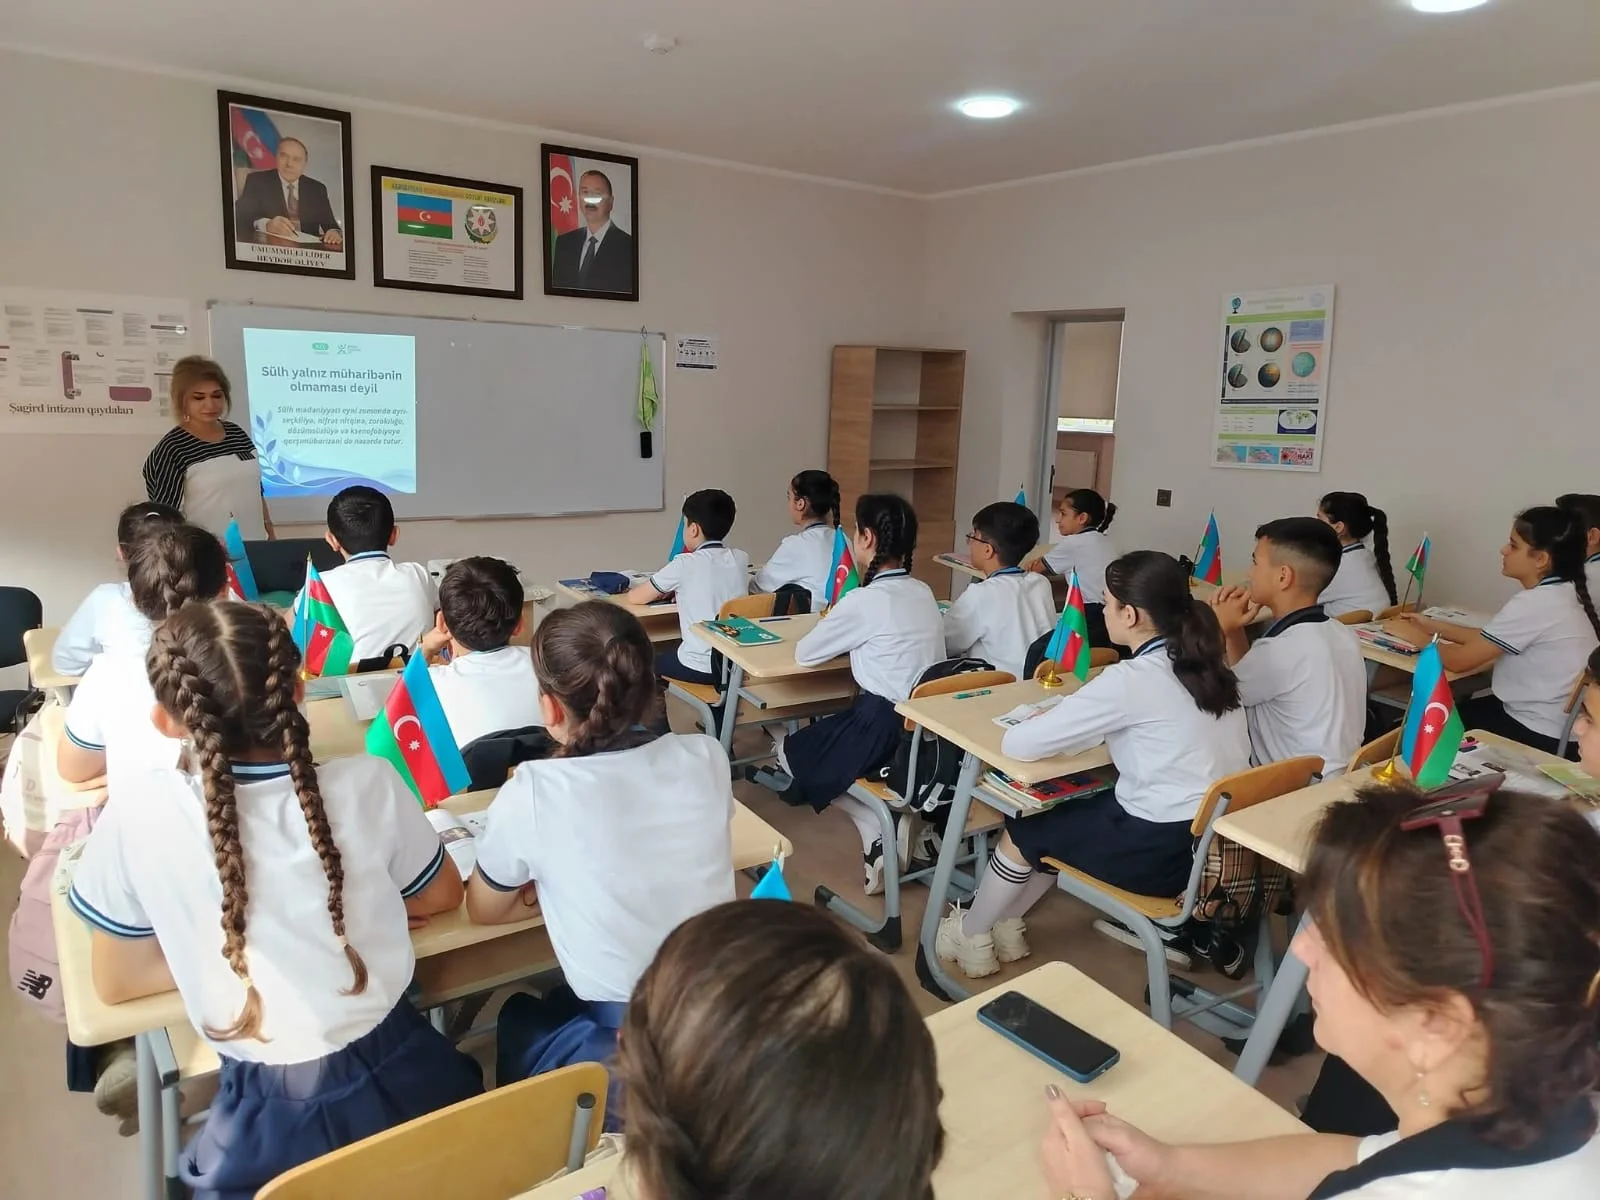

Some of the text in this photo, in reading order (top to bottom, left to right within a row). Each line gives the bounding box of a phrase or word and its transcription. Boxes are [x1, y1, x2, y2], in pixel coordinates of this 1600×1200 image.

[261, 366, 403, 381] Sülh yalnız müharibənin
[290, 382, 378, 395] olmaması deyil
[8, 402, 134, 417] Şagird intizam qaydaları
